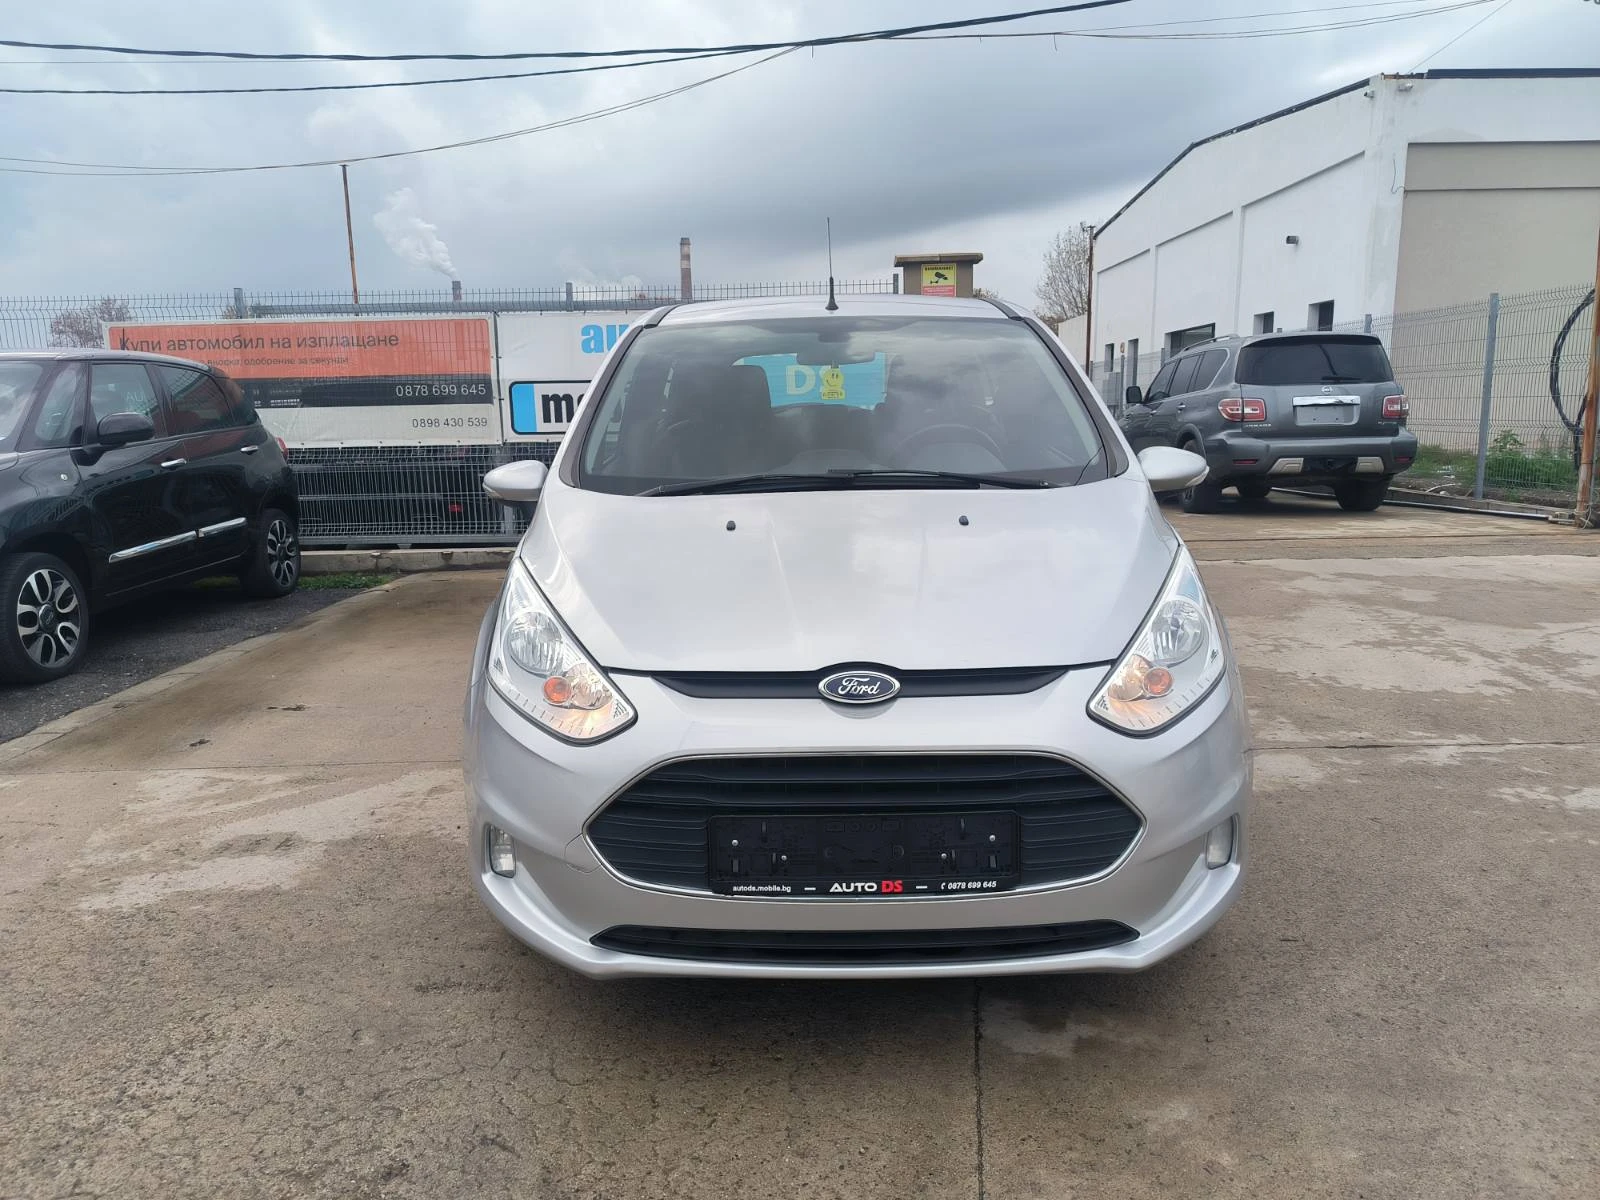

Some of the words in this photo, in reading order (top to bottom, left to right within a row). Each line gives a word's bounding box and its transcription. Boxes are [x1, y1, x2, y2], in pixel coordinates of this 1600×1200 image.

[167, 335, 265, 351] автомобил
[270, 337, 292, 349] на
[297, 334, 400, 349] изплащане
[395, 384, 428, 397] 0878
[432, 384, 457, 396] 699
[461, 384, 486, 395] 645
[412, 418, 440, 428] 0898
[443, 417, 464, 427] 430
[467, 417, 488, 427] 539
[838, 677, 880, 695] Ford
[829, 882, 878, 893] AUTO
[881, 880, 903, 893] DS
[947, 882, 966, 890] 0878
[982, 880, 997, 889] 645
